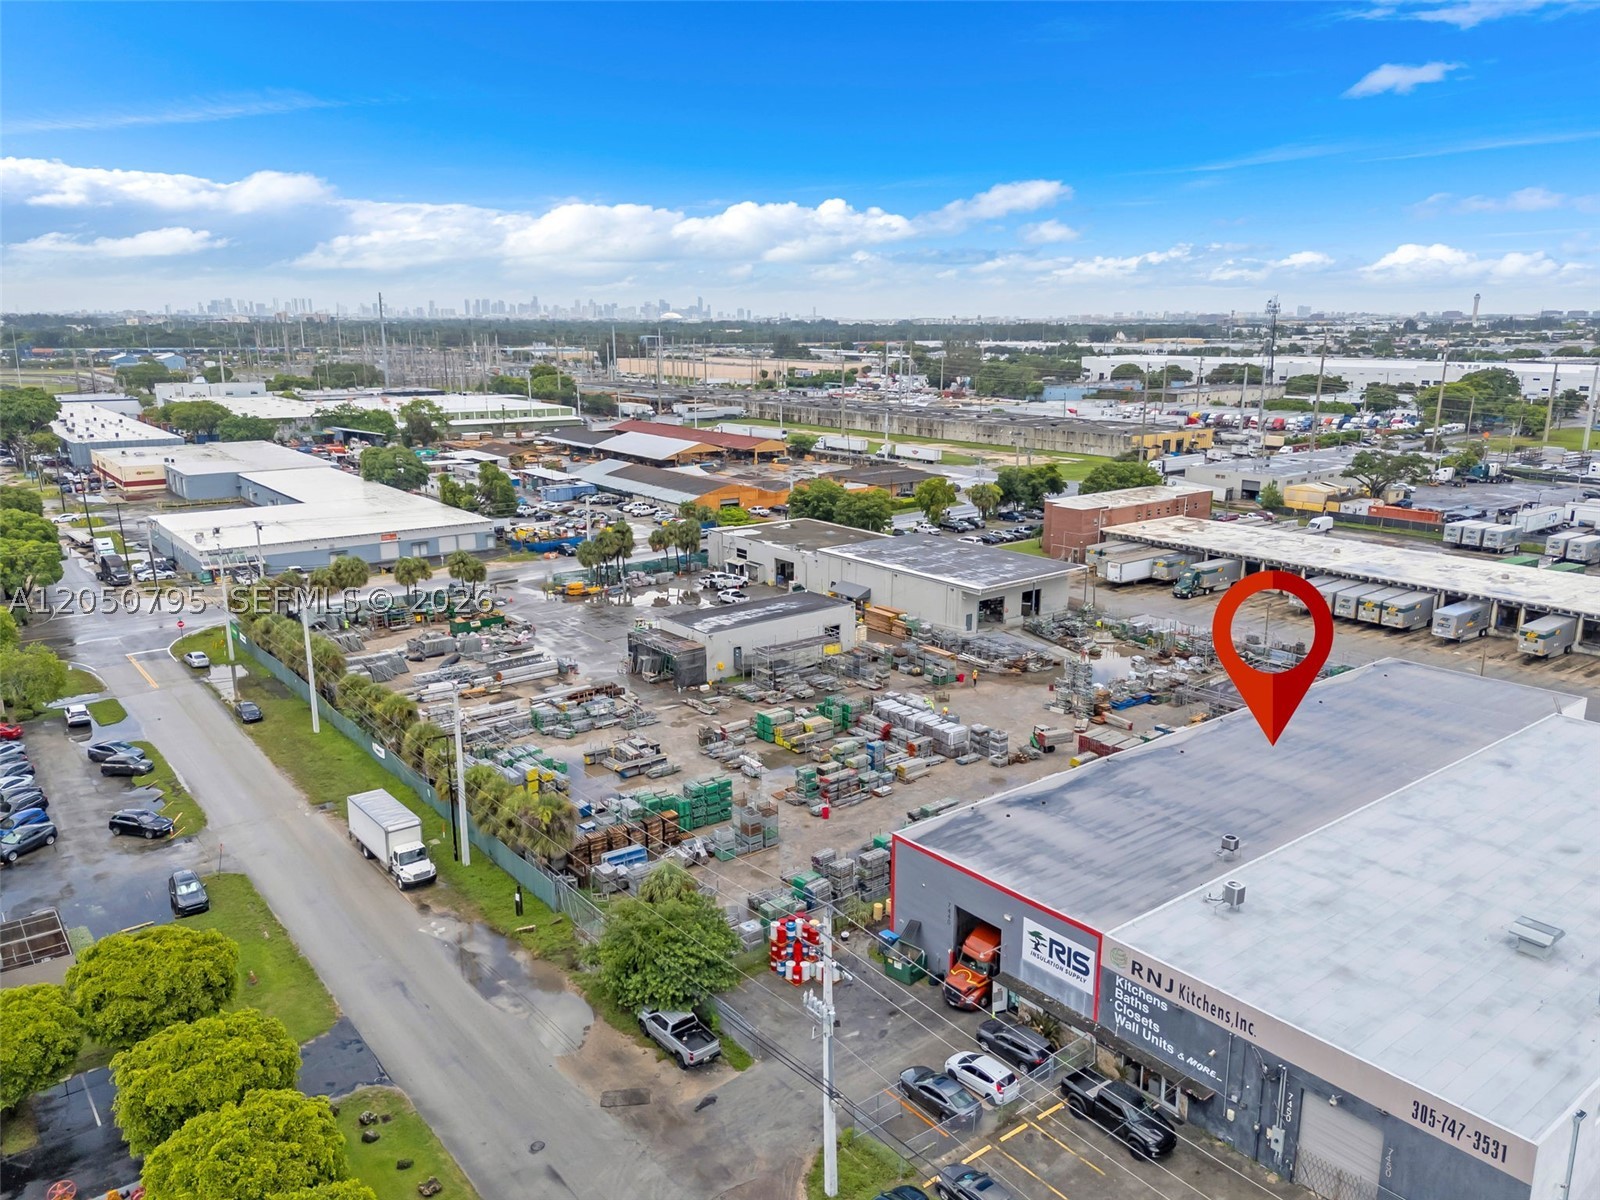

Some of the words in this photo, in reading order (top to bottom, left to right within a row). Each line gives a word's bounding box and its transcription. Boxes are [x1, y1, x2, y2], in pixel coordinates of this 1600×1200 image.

[1030, 950, 1064, 972] INSULATION
[1065, 968, 1087, 984] SUPPLY
[1048, 937, 1090, 977] RIS
[1115, 975, 1168, 1011] Kitchens
[1131, 960, 1174, 993] RNJ
[1114, 987, 1149, 1014] Baths
[1114, 1000, 1160, 1033] Closets
[1114, 1011, 1139, 1035] Wall
[1142, 1027, 1174, 1055] Units
[1177, 1052, 1185, 1061] &
[1285, 1092, 1294, 1122] 7450
[1411, 1100, 1508, 1163] 305-747-3531
[1385, 1147, 1394, 1178] 7450
